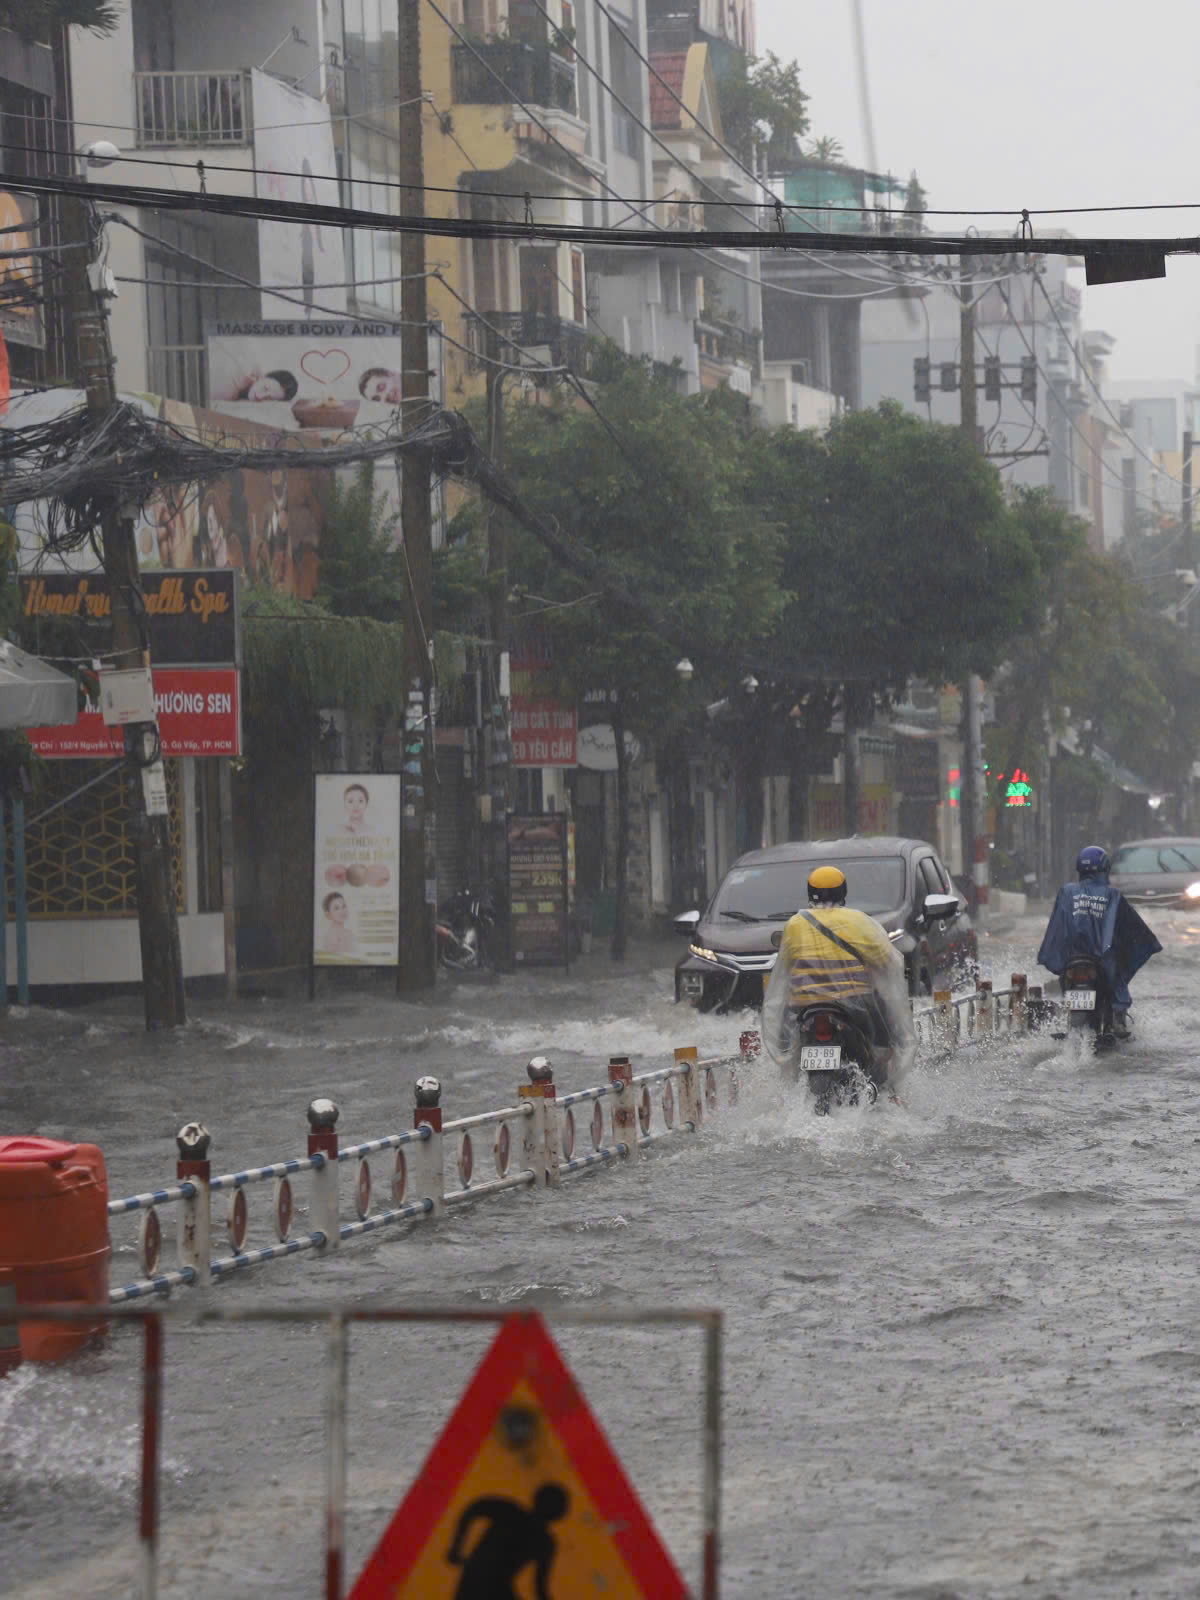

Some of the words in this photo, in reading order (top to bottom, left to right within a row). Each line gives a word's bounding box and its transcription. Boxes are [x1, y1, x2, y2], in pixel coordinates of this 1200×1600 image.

[217, 323, 295, 336] MASSAGE
[300, 323, 345, 336] BODY
[352, 323, 386, 336] AND
[191, 577, 229, 623] Spa
[208, 693, 232, 713] SEN
[214, 740, 232, 749] HCM
